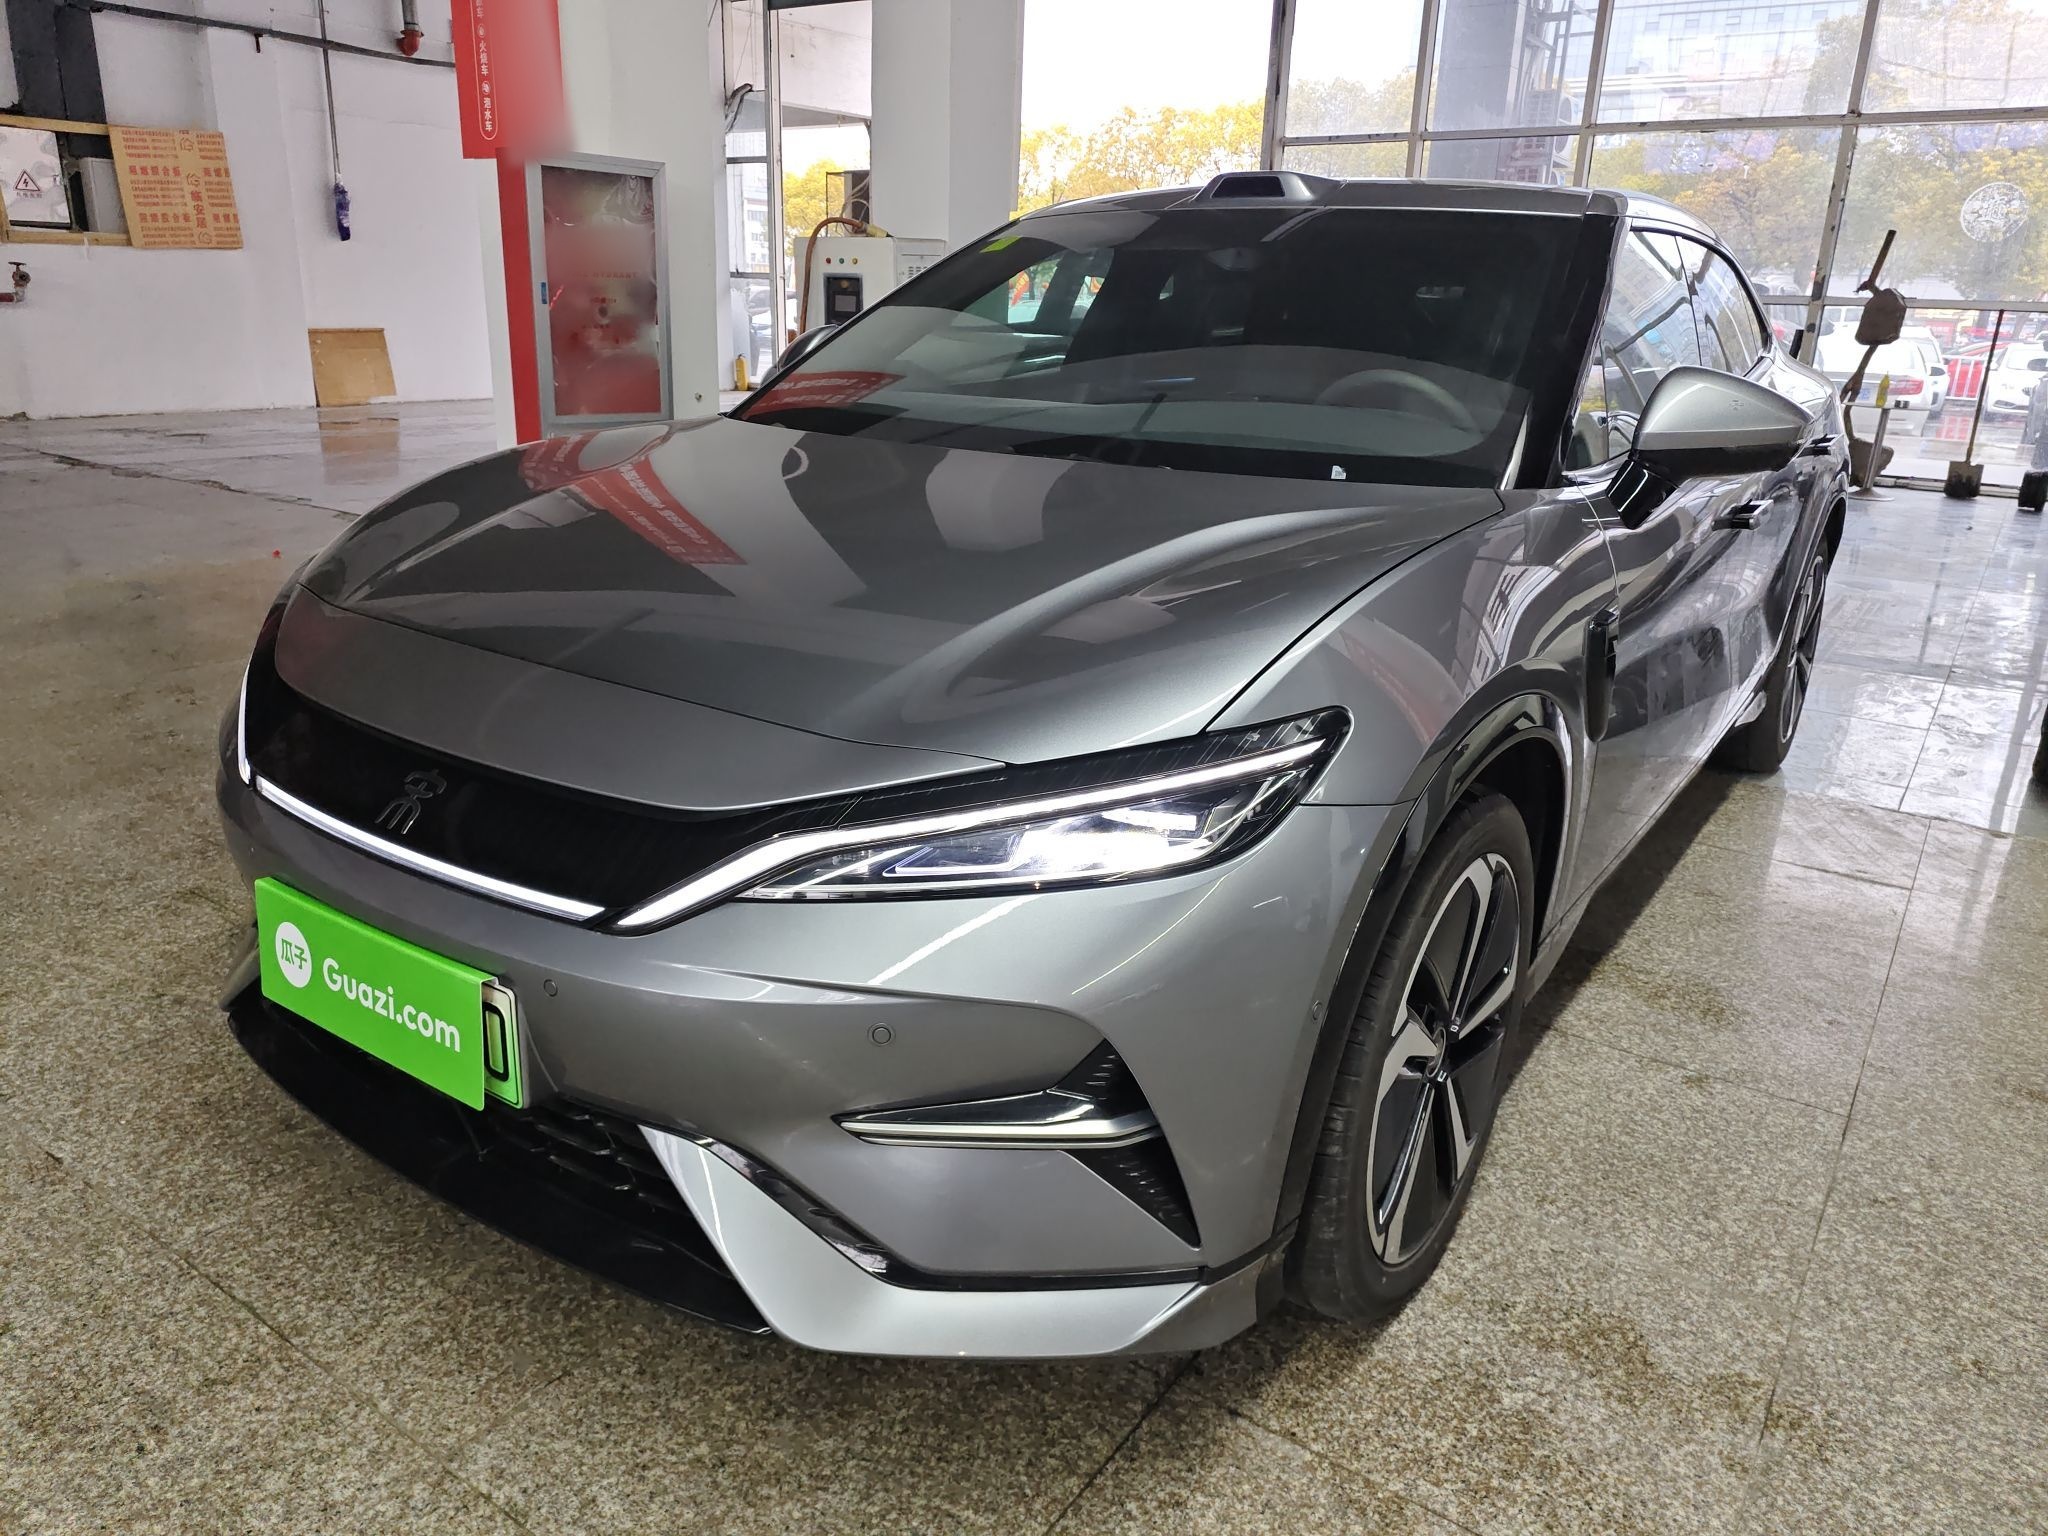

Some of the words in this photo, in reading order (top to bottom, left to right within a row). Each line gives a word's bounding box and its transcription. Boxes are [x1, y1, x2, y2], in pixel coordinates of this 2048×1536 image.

[480, 41, 489, 76] 火烧车
[484, 97, 493, 132] 泡水车
[281, 938, 307, 970] 瓜子
[323, 957, 460, 1053] Guazi.com
